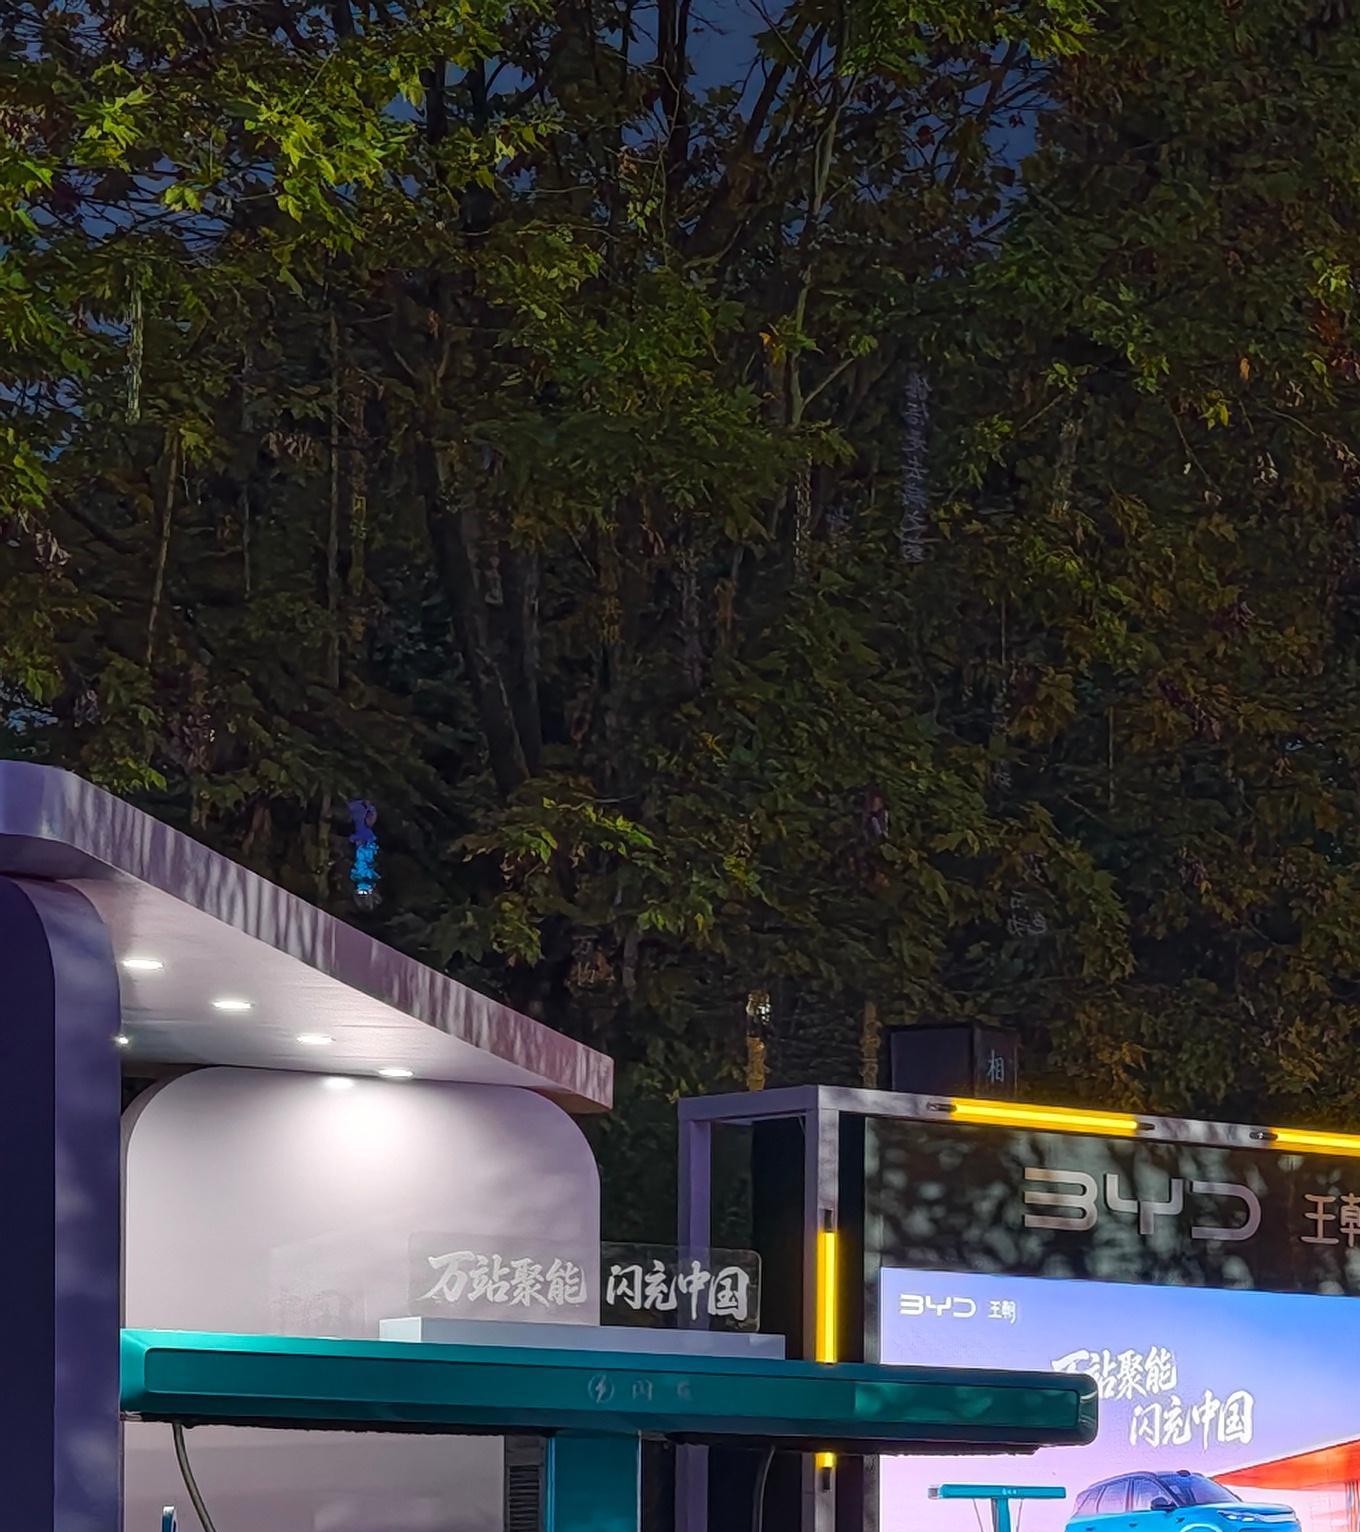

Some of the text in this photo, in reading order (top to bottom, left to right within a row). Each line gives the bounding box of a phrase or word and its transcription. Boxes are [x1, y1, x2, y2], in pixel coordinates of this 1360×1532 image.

[1024, 1167, 1262, 1241] BYD
[420, 1250, 748, 1321] 万站聚能 闪充中国
[900, 1294, 976, 1318] BYD
[1129, 1389, 1255, 1450] 闪充中国
